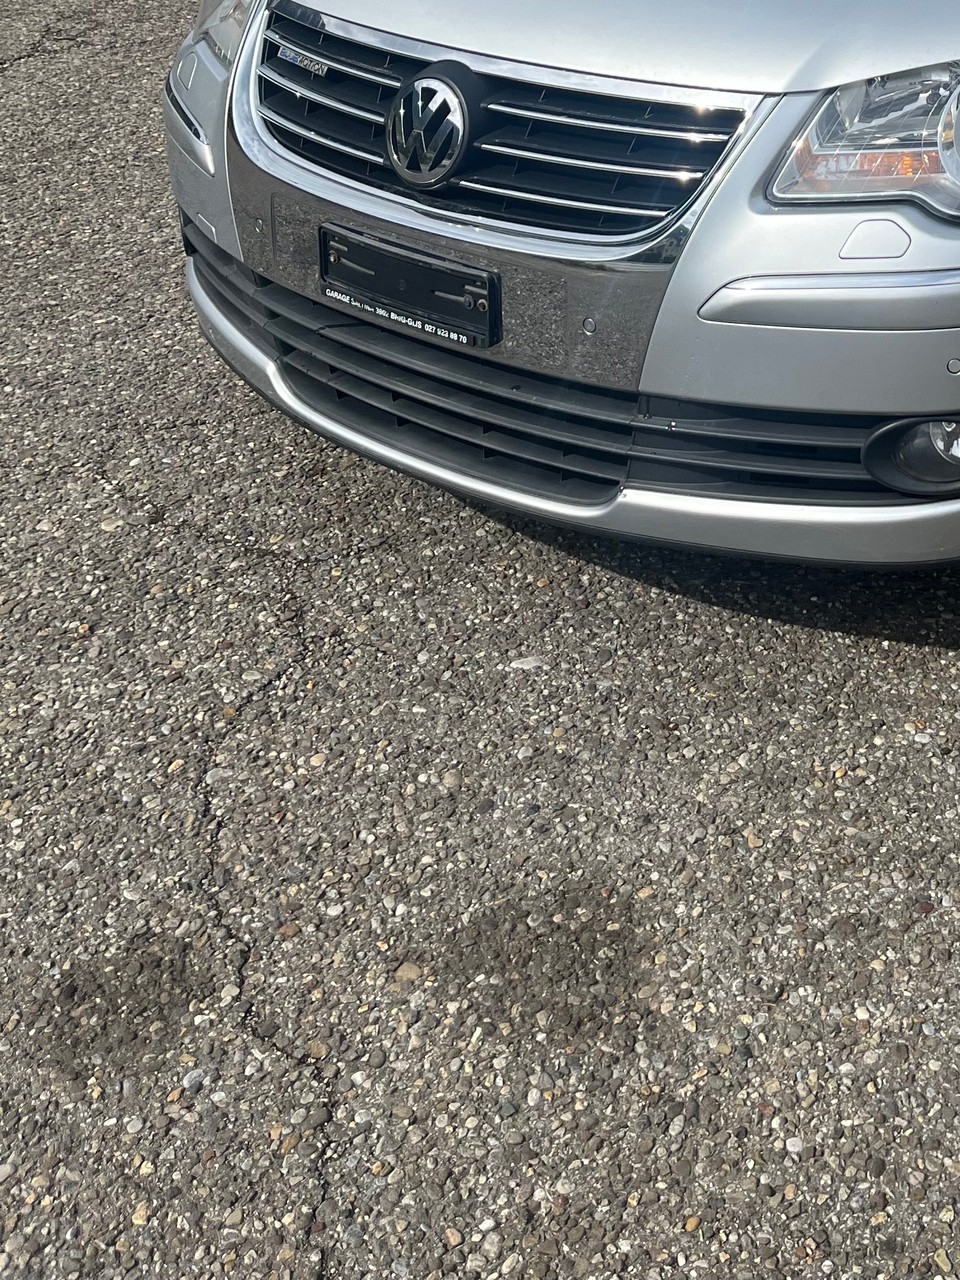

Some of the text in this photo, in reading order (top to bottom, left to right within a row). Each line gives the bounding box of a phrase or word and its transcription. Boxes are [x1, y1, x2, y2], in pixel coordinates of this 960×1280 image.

[388, 78, 464, 184] VW
[325, 288, 350, 303] GARAGE
[424, 323, 436, 333] 027
[458, 334, 468, 344] 70
